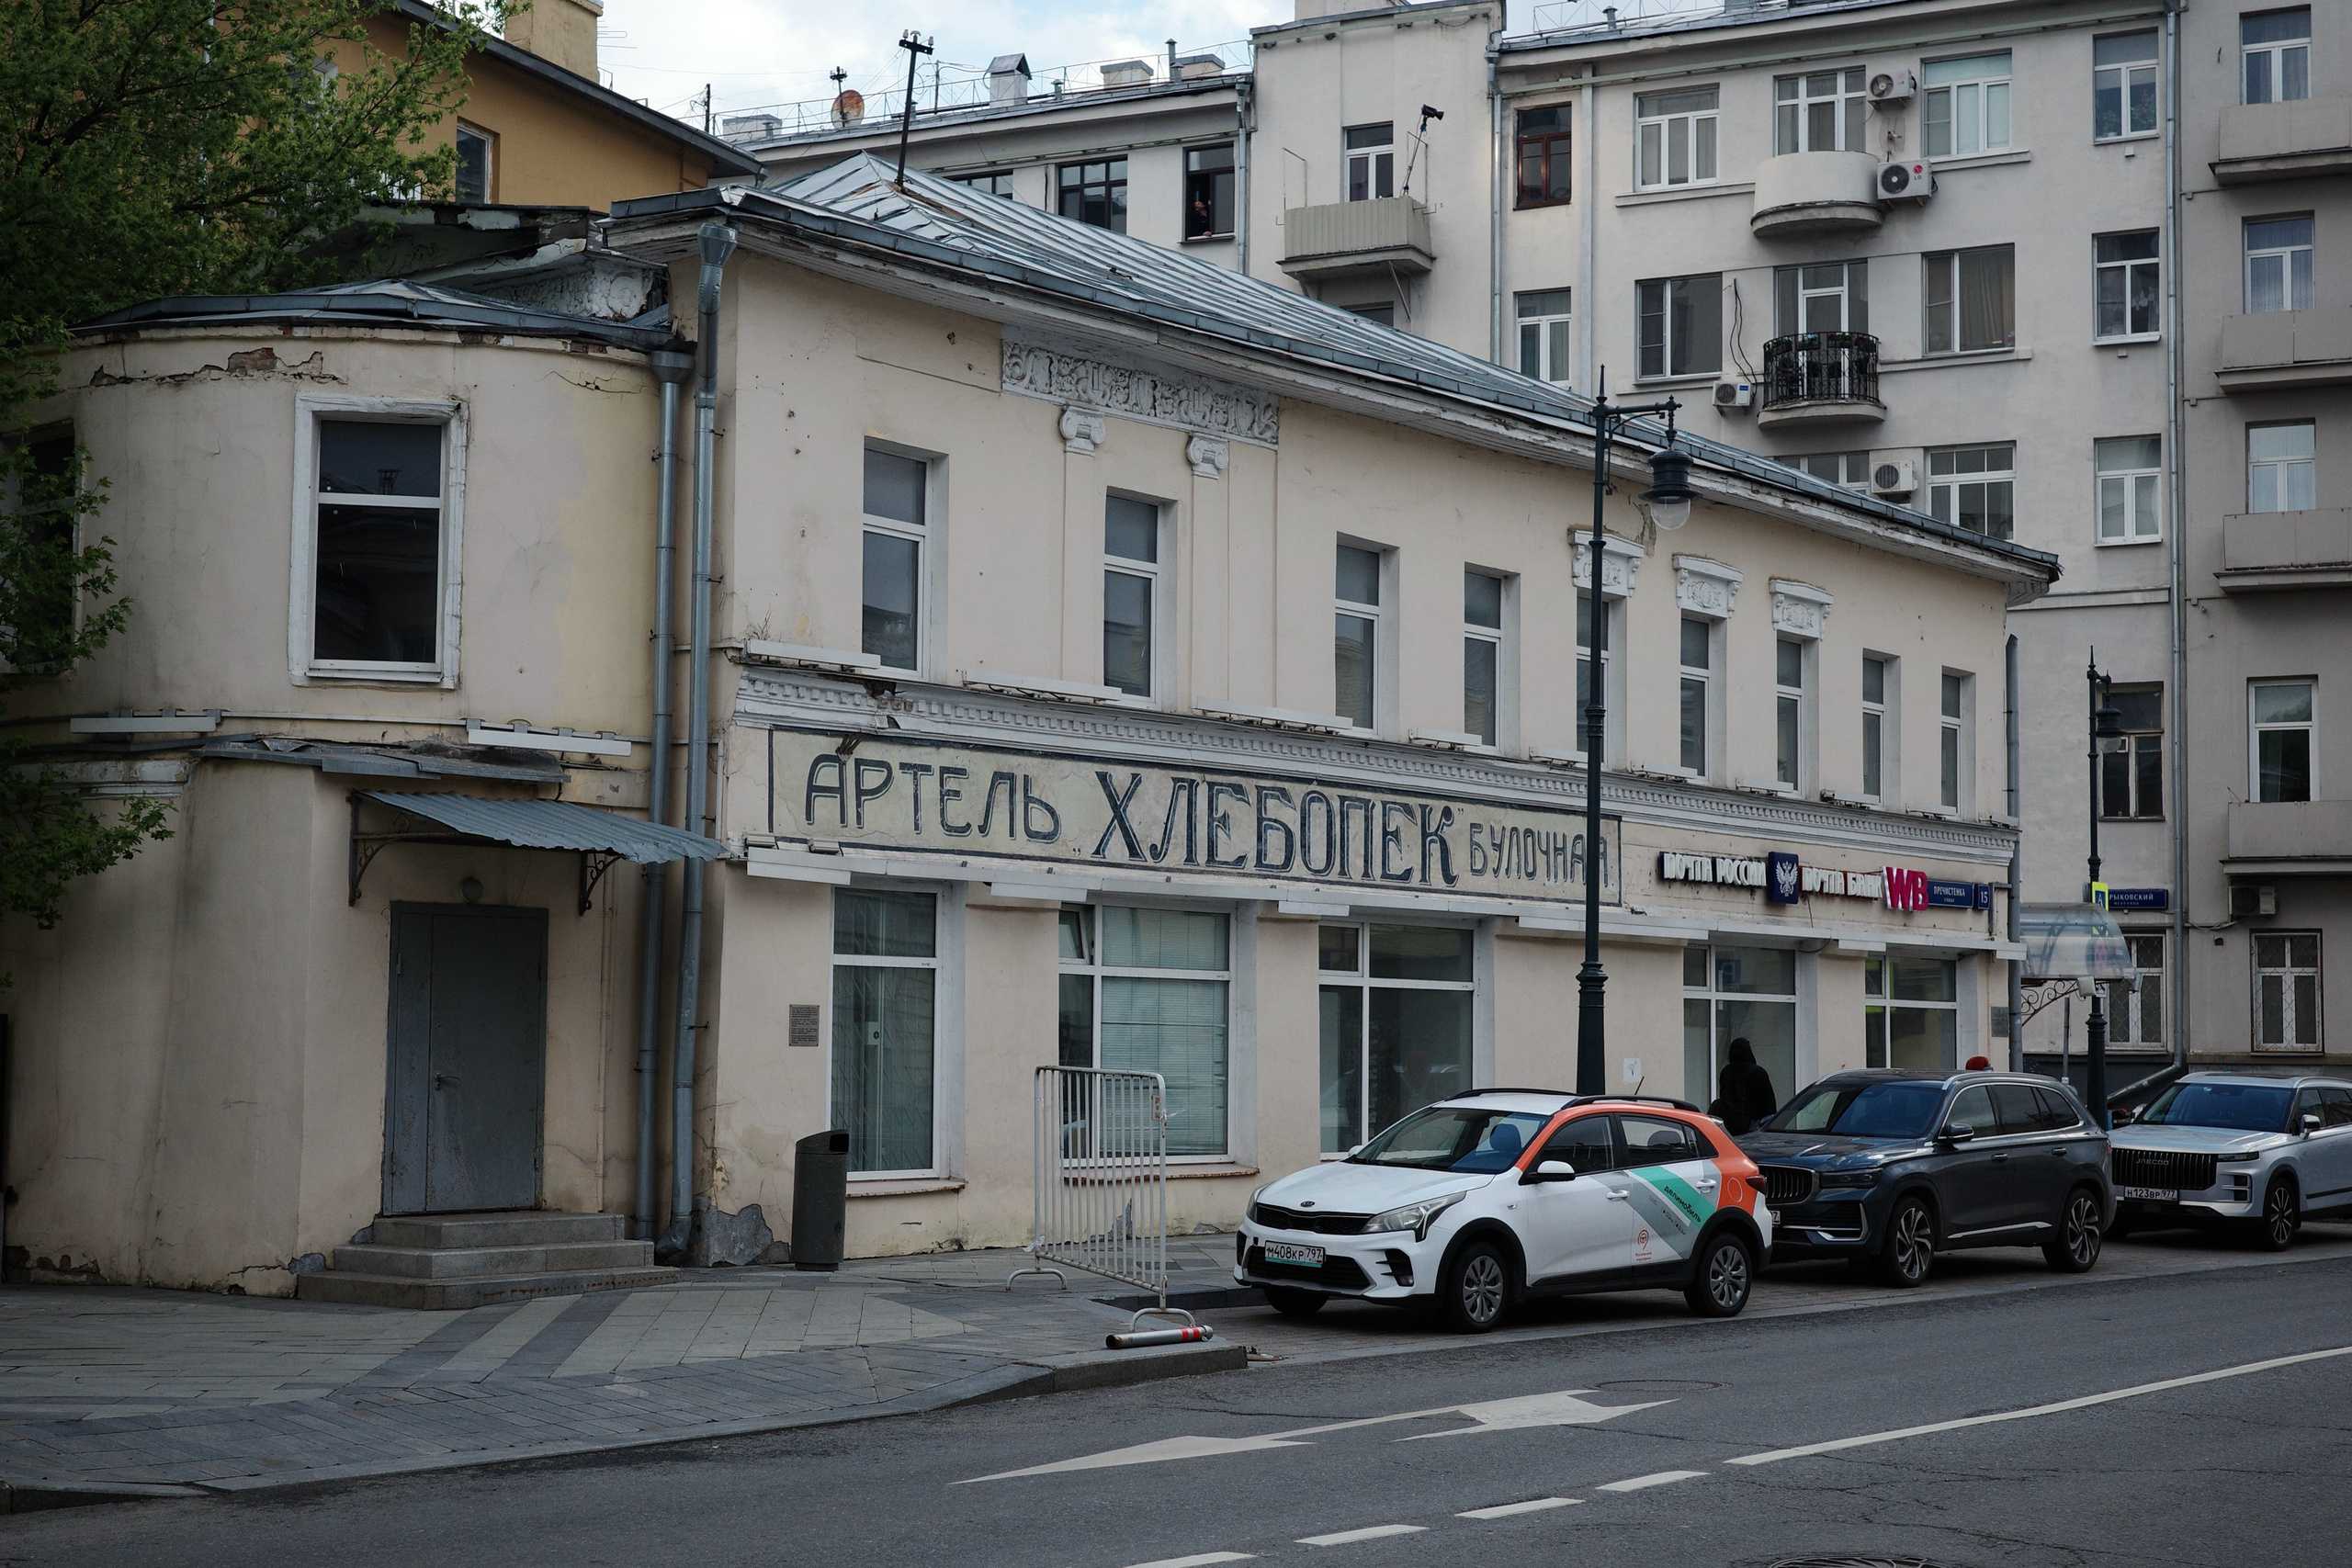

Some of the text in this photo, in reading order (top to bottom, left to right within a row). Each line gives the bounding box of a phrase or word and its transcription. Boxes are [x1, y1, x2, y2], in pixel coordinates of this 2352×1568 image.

[805, 753, 1061, 843] АРТЕЛЬ
[1664, 852, 1766, 886] ПОЧТА РОССИИ
[1802, 867, 1883, 898] ПОЧТА БАНК
[1883, 865, 1928, 911] WB
[1933, 886, 1965, 897] ПРЕЧИСТЕНКА
[1980, 891, 1988, 904] 15
[1664, 1186, 1702, 1223] делимобиль
